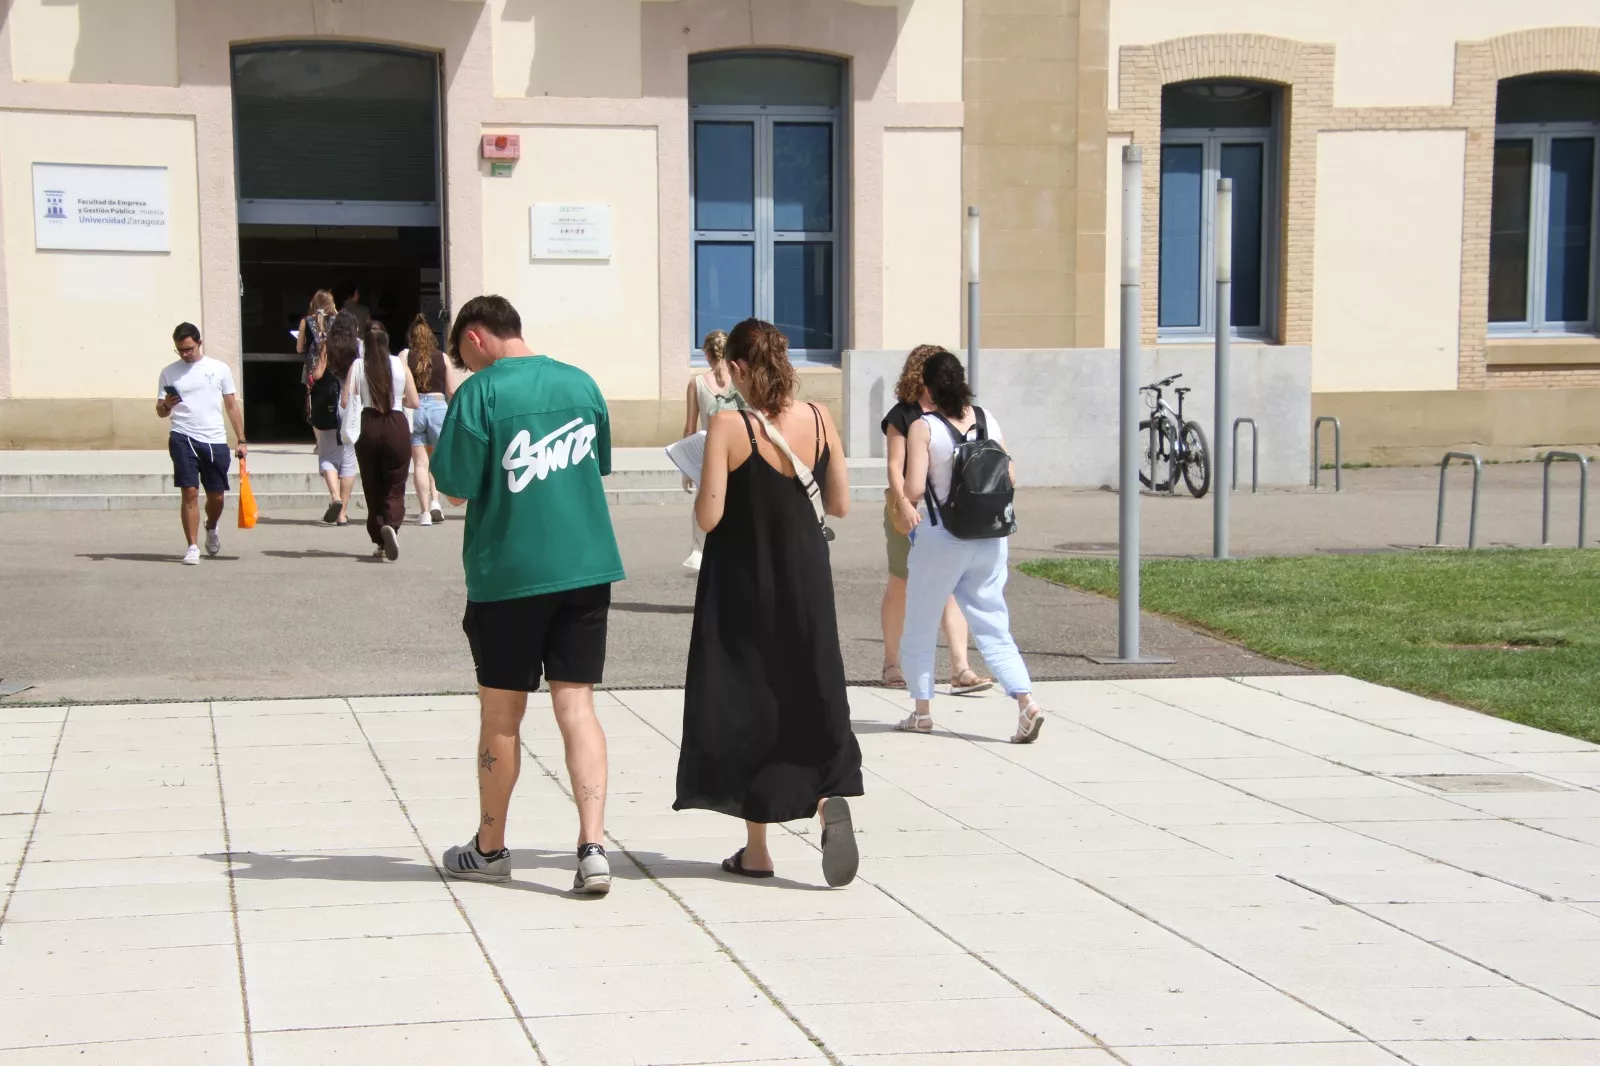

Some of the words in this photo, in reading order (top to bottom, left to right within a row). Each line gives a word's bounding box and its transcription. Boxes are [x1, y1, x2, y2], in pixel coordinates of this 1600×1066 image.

[77, 198, 107, 206] Facultad
[117, 199, 147, 207] Empresa
[79, 216, 126, 224] Universidad
[126, 217, 165, 227] Zaragoza
